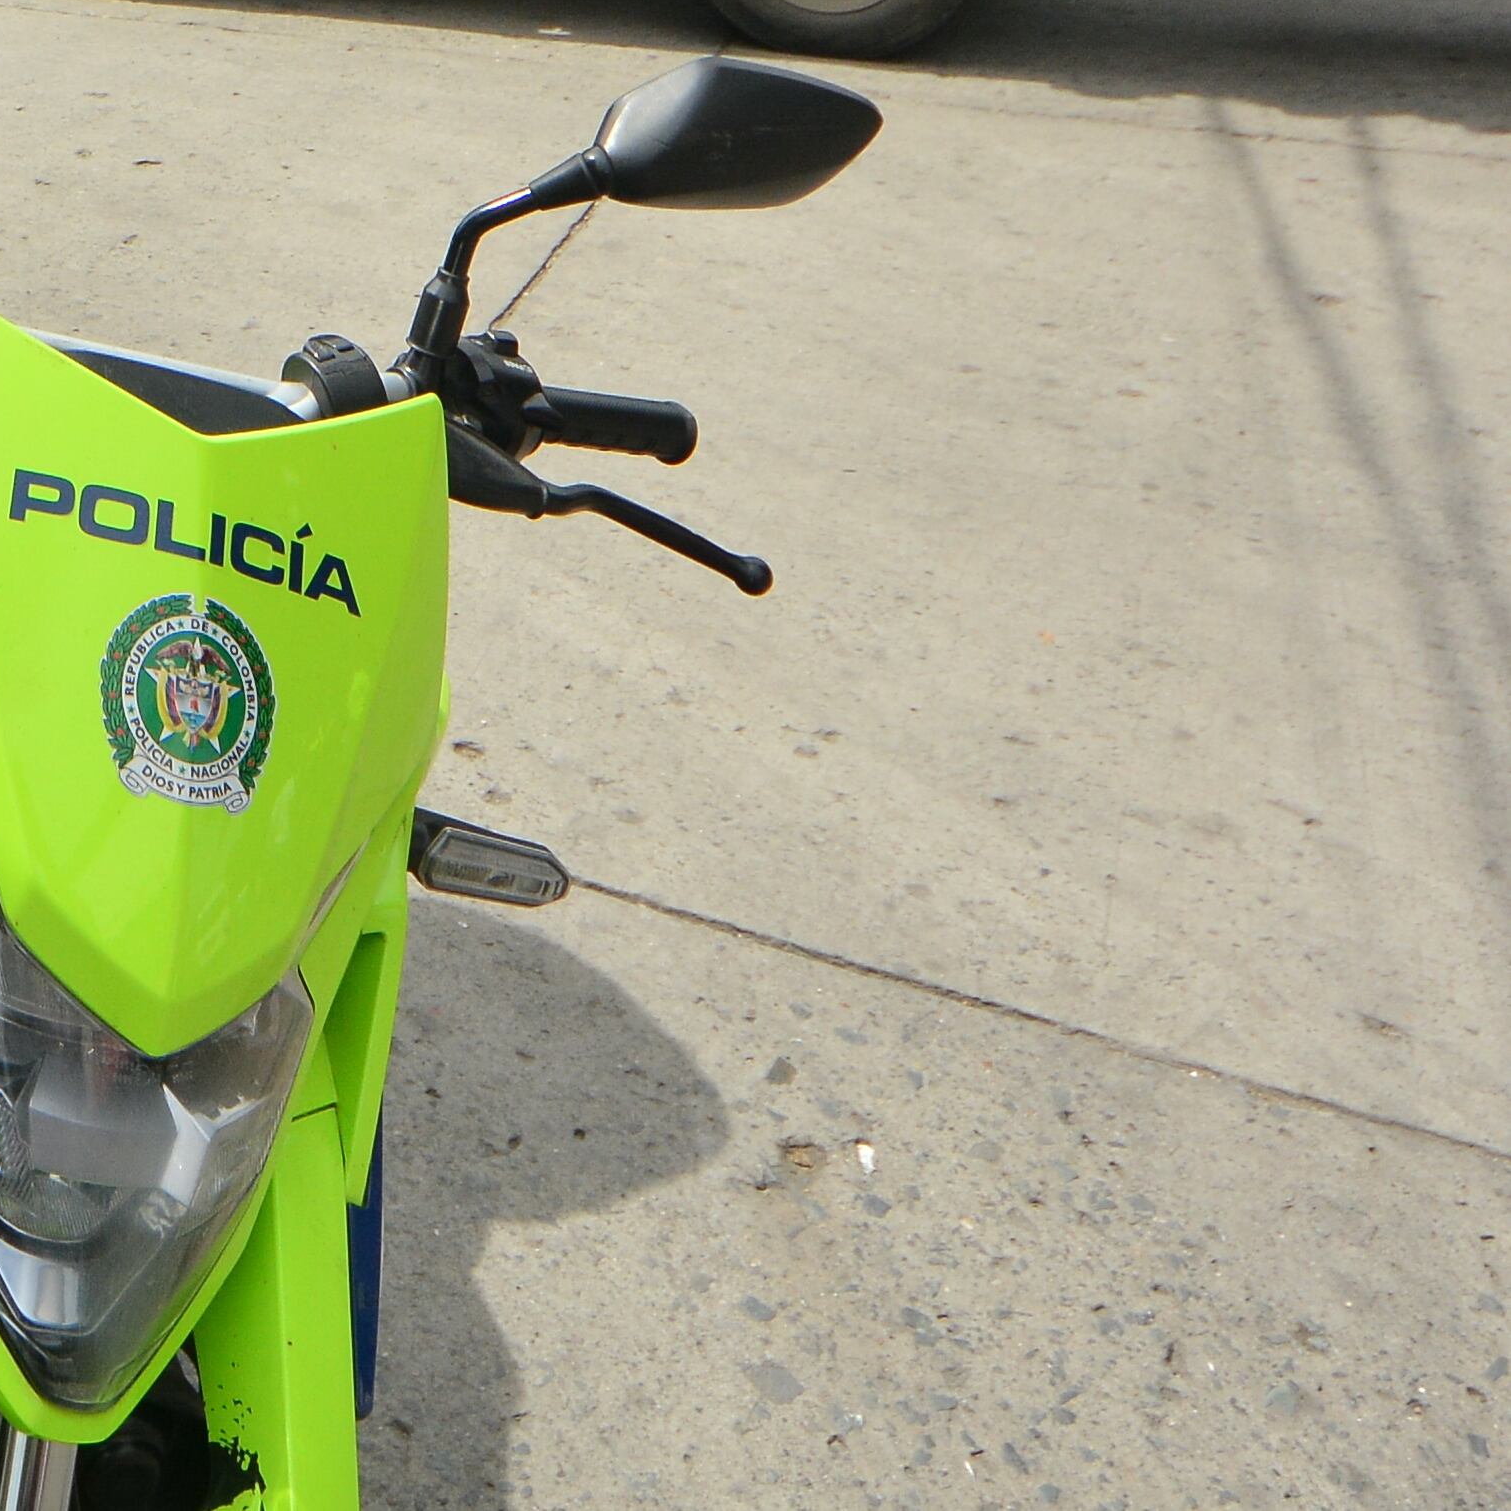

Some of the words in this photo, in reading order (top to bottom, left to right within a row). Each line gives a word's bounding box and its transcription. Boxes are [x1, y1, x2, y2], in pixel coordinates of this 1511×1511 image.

[9, 467, 362, 619] POLICÍA
[125, 620, 176, 696] REPUBLICA
[191, 618, 210, 633] DE
[221, 635, 256, 722] COLOMBIA
[142, 763, 175, 791] DIOS
[176, 782, 186, 796] Y
[188, 781, 233, 801] PATRIA
[191, 740, 249, 779] NACIONAL
